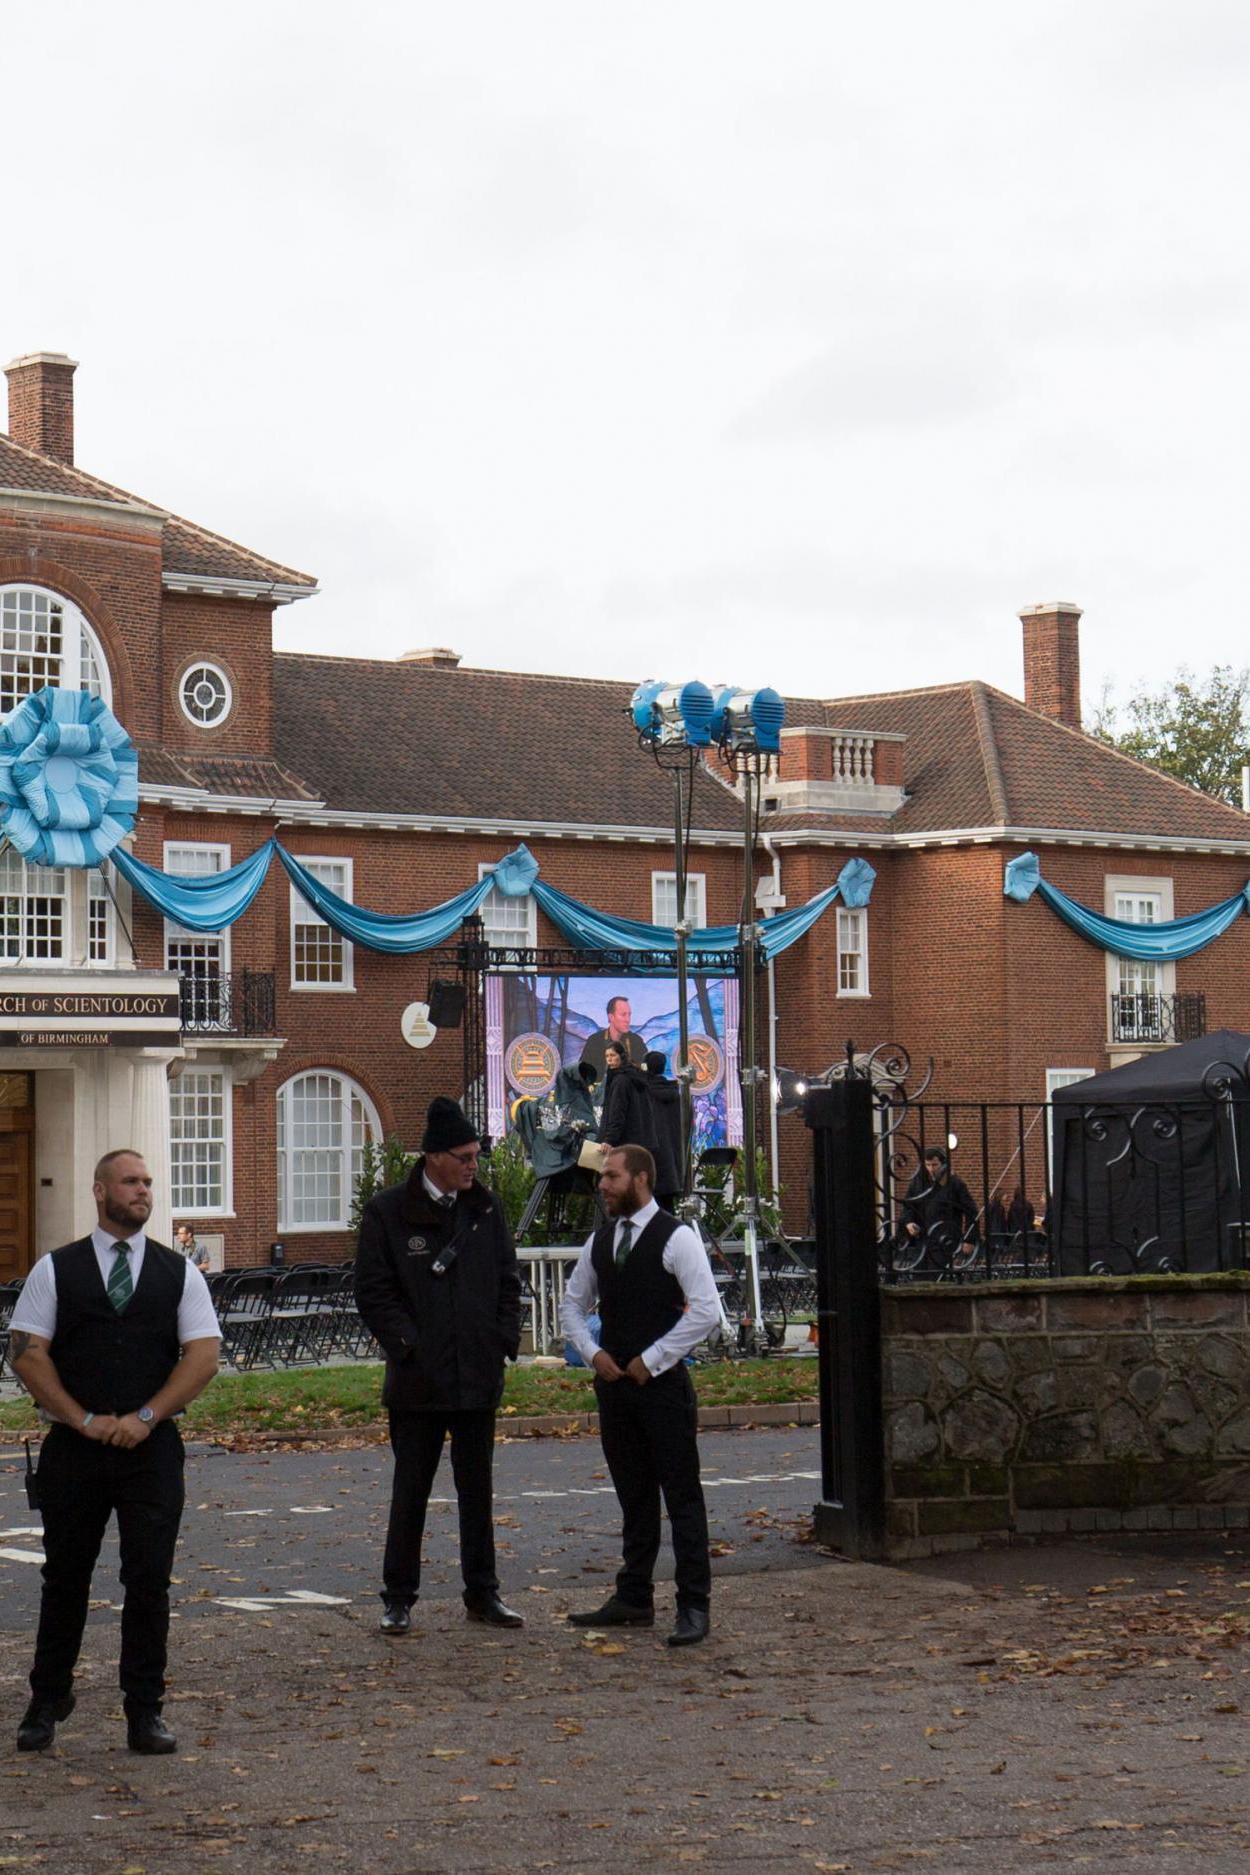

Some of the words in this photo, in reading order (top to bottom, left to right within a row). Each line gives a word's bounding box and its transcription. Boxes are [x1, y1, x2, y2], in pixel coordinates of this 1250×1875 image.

[31, 998, 49, 1012] OF
[53, 997, 168, 1014] SCIENTOLOGY
[20, 1033, 35, 1044] OF
[38, 1033, 109, 1044] BIRMINGHAM
